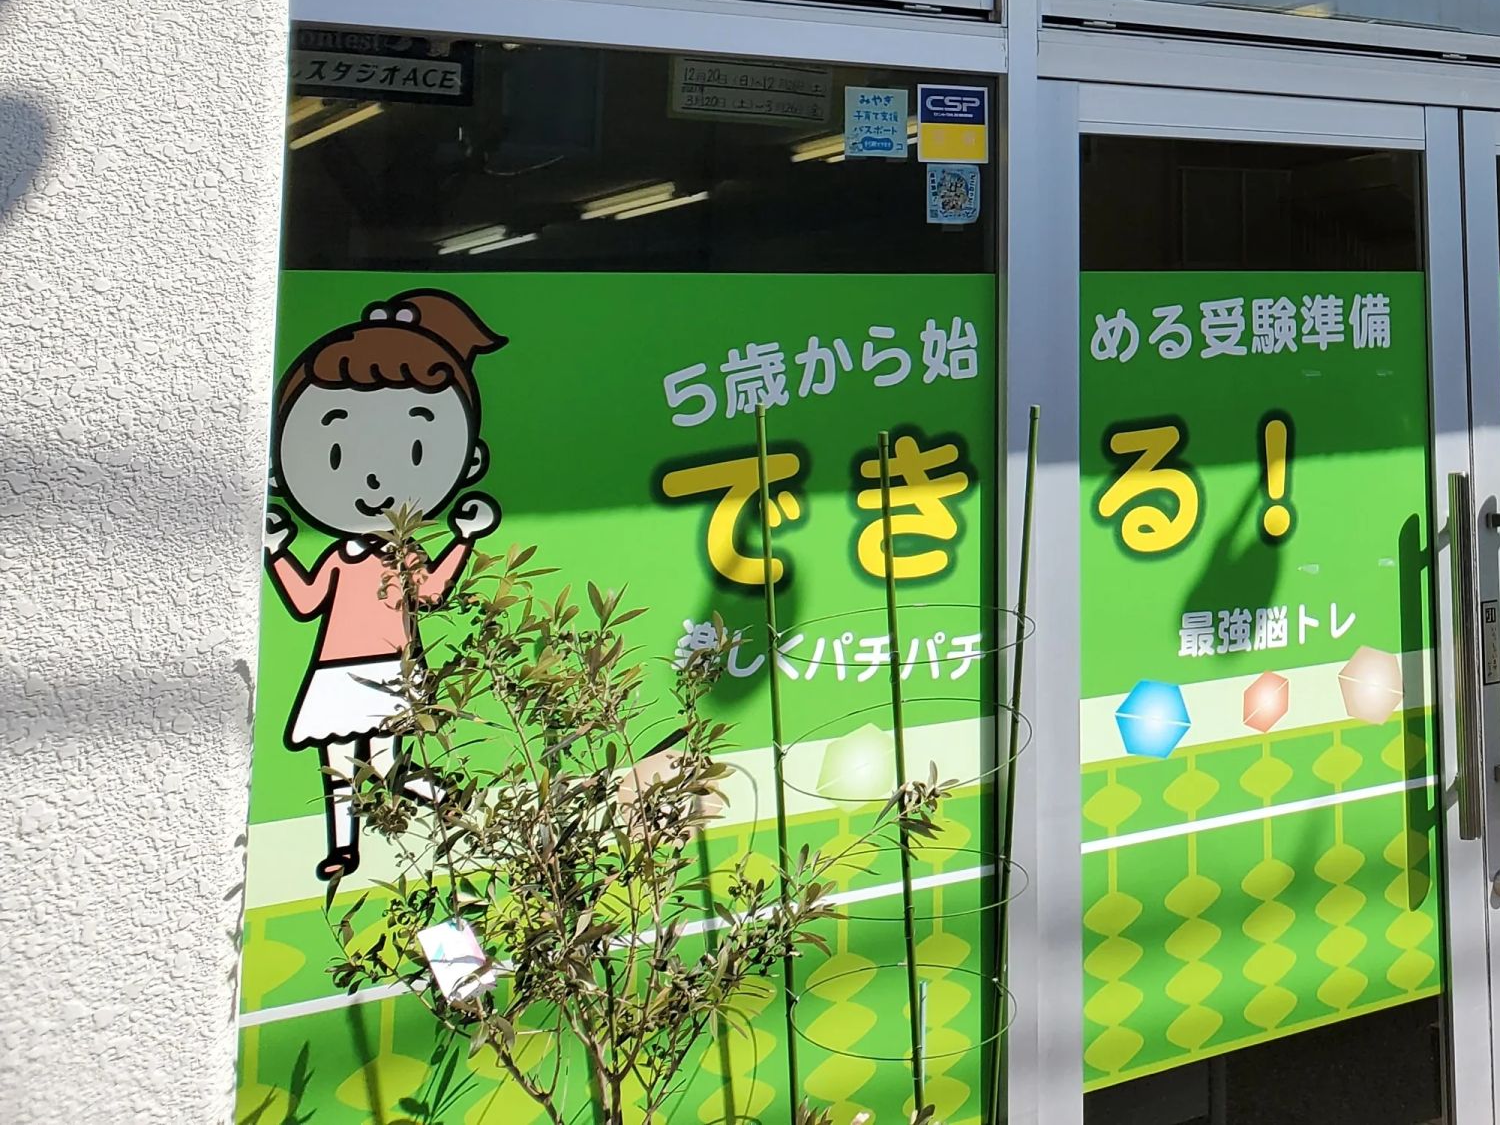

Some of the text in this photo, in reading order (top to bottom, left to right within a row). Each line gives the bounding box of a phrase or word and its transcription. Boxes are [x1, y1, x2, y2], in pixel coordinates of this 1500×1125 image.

[296, 60, 458, 90] スタジオACE
[859, 94, 894, 107] みやぎ
[925, 95, 980, 112] CSP
[663, 316, 978, 427] 5歳から始
[1090, 293, 1392, 363] める受験準備
[662, 435, 969, 585] でき
[1178, 602, 1356, 658] 最強脳トレ
